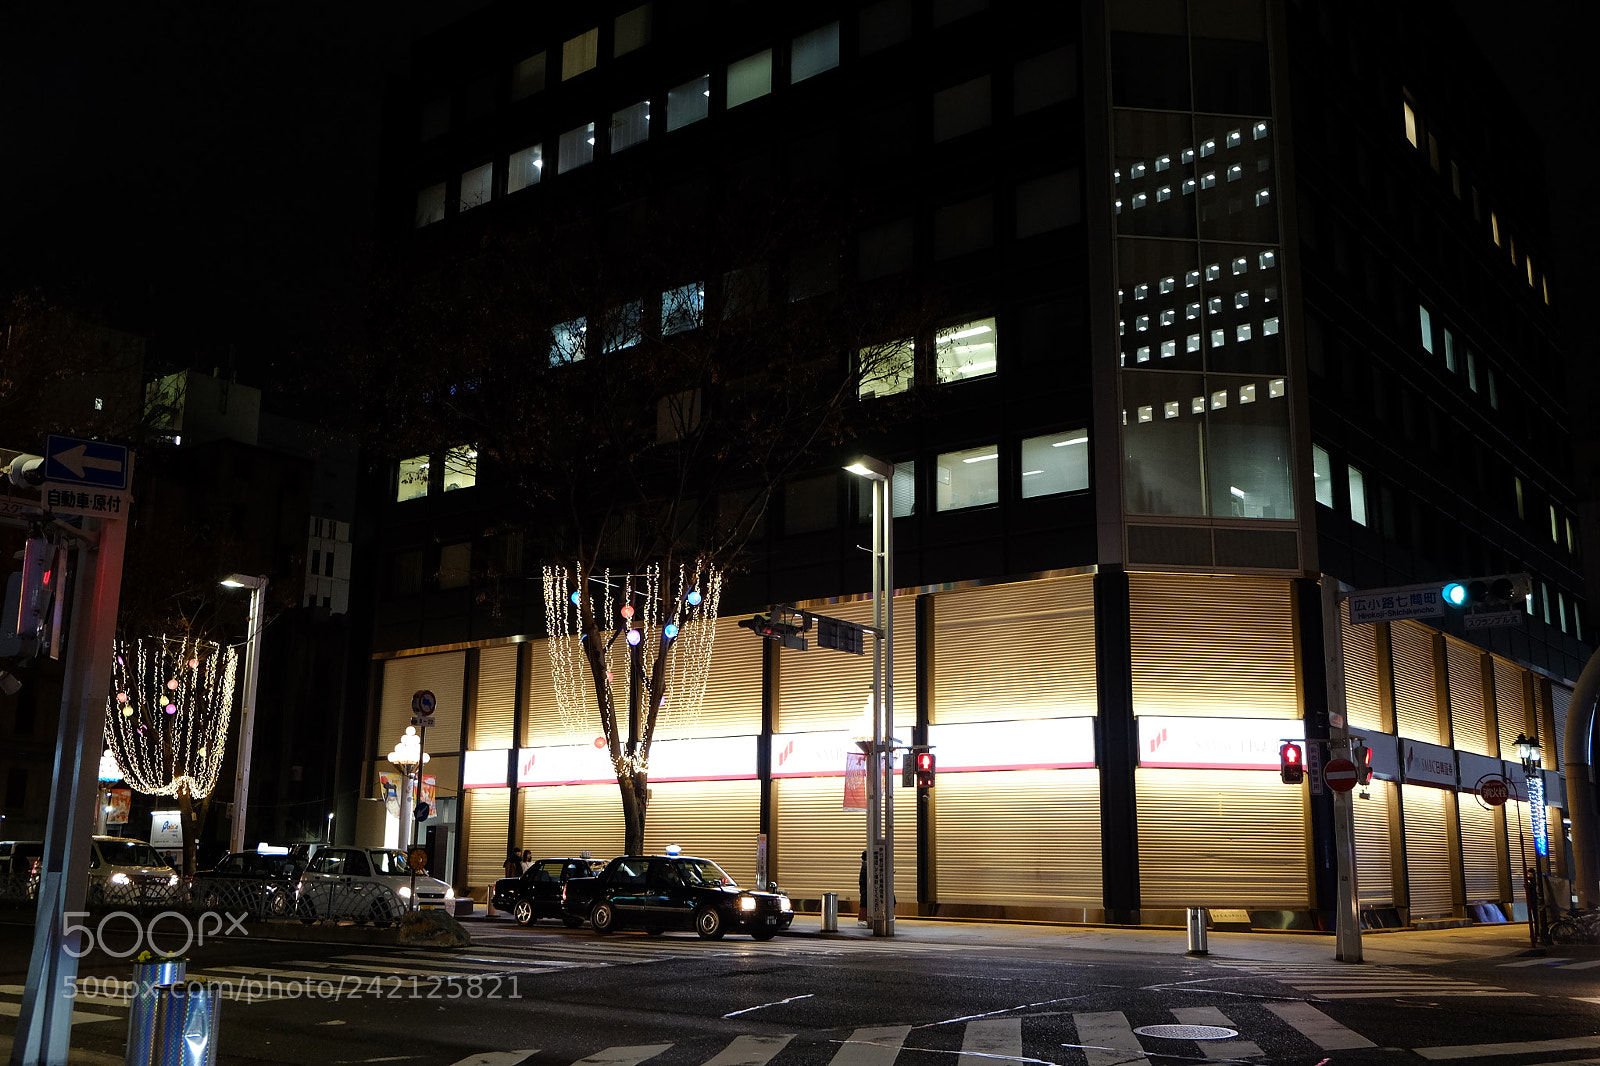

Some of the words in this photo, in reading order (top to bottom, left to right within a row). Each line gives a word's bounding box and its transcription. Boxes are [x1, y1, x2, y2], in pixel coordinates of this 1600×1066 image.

[1354, 592, 1437, 612] 広小路七間町
[1357, 607, 1435, 620] Hirokoji-Shichikencho
[1483, 787, 1508, 799] 消火栓
